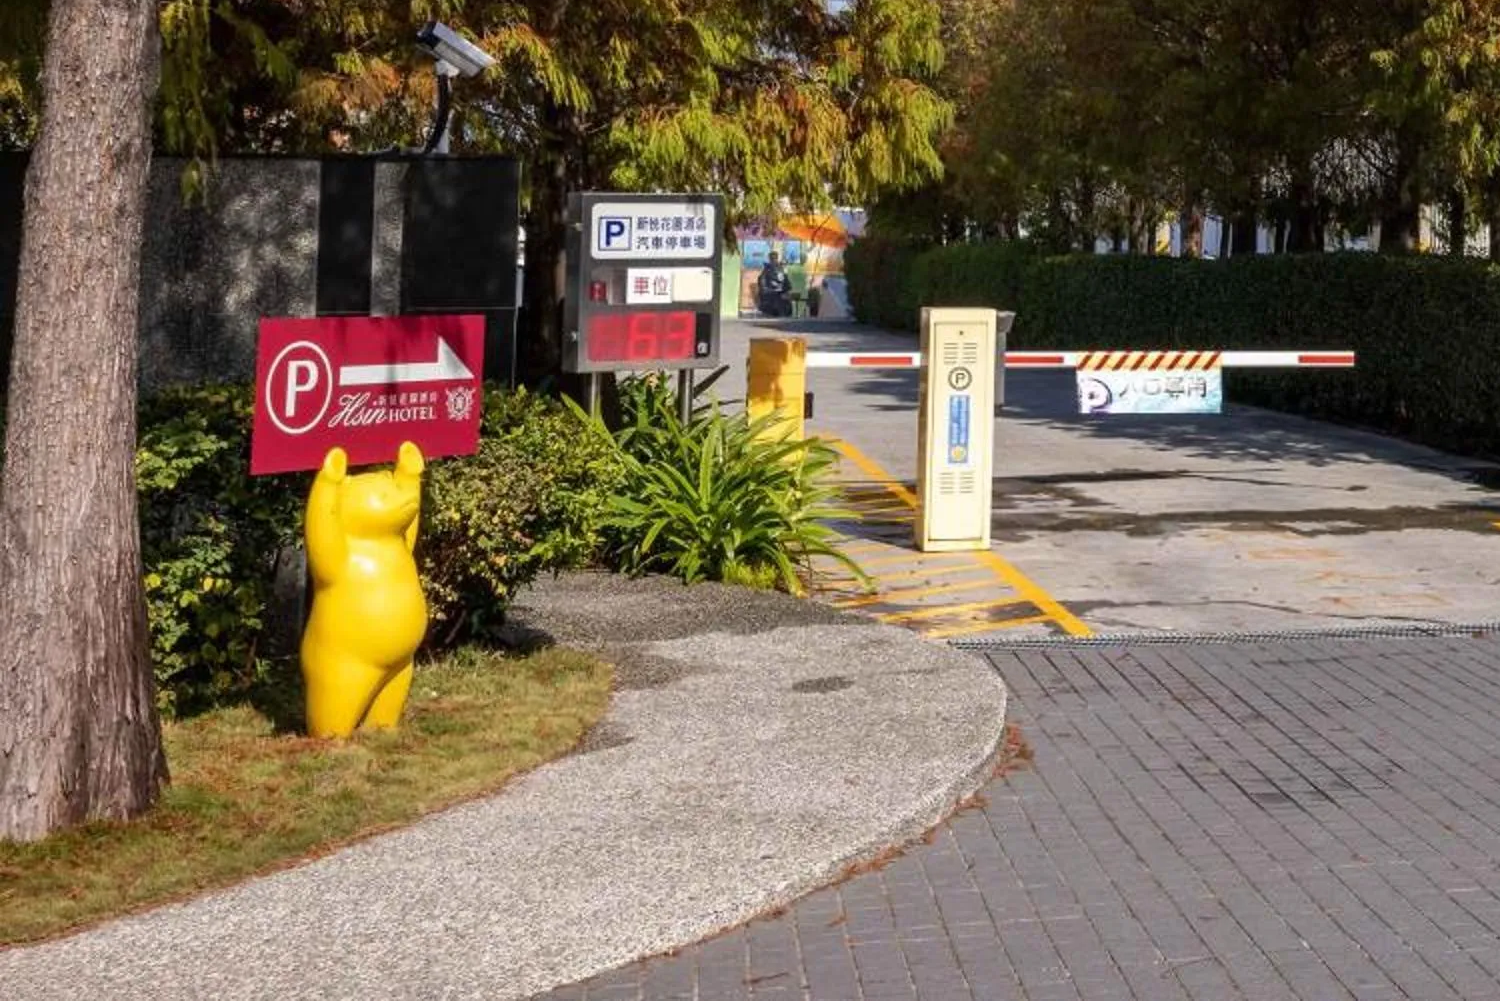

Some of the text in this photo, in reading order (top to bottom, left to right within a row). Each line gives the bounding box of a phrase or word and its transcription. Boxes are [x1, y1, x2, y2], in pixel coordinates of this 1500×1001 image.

[605, 220, 625, 247] P
[637, 236, 706, 249] 汽車停車場
[633, 275, 669, 296] 車位
[286, 360, 318, 418] P
[327, 392, 438, 428] Hsin HOTEL
